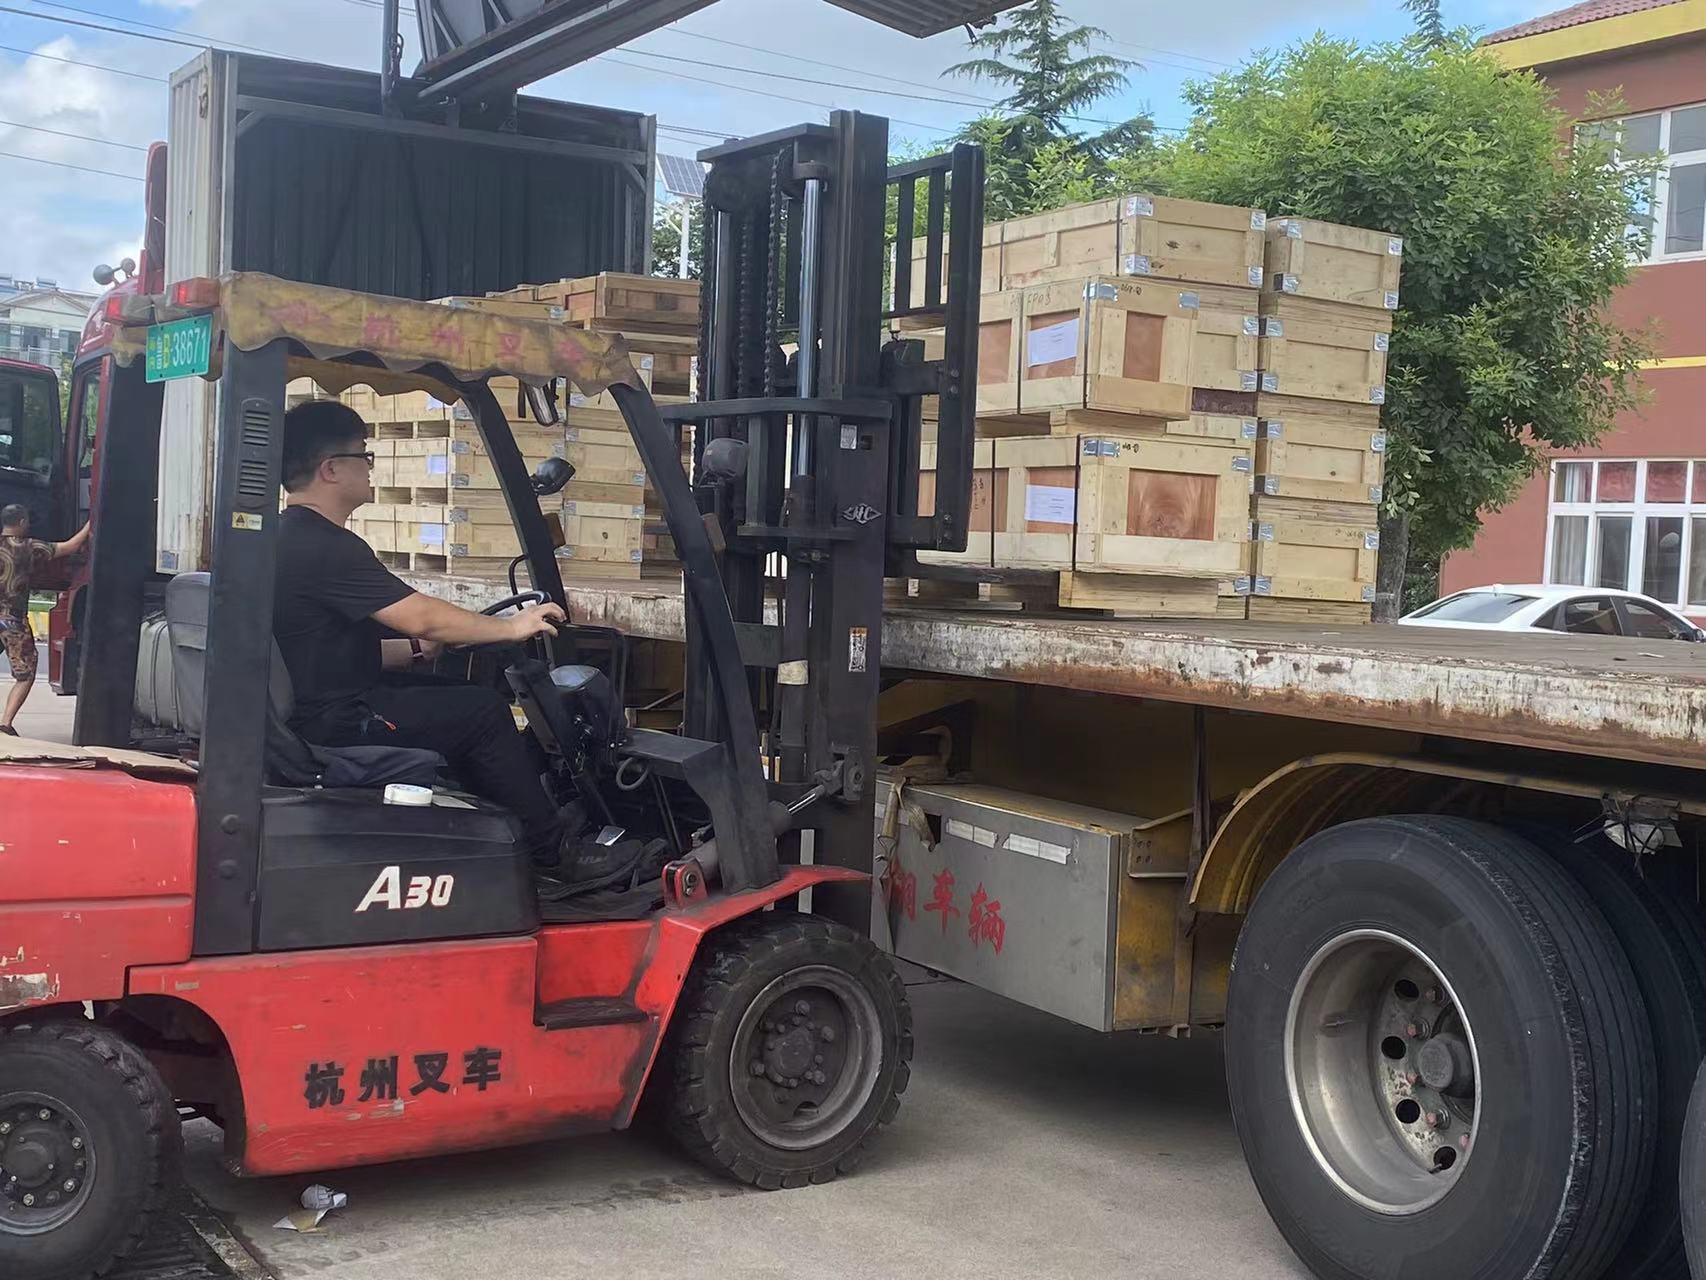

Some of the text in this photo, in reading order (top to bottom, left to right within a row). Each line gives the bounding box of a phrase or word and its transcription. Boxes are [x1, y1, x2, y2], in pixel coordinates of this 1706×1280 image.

[354, 865, 454, 912] A30
[303, 1047, 502, 1109] 杭州叉车
